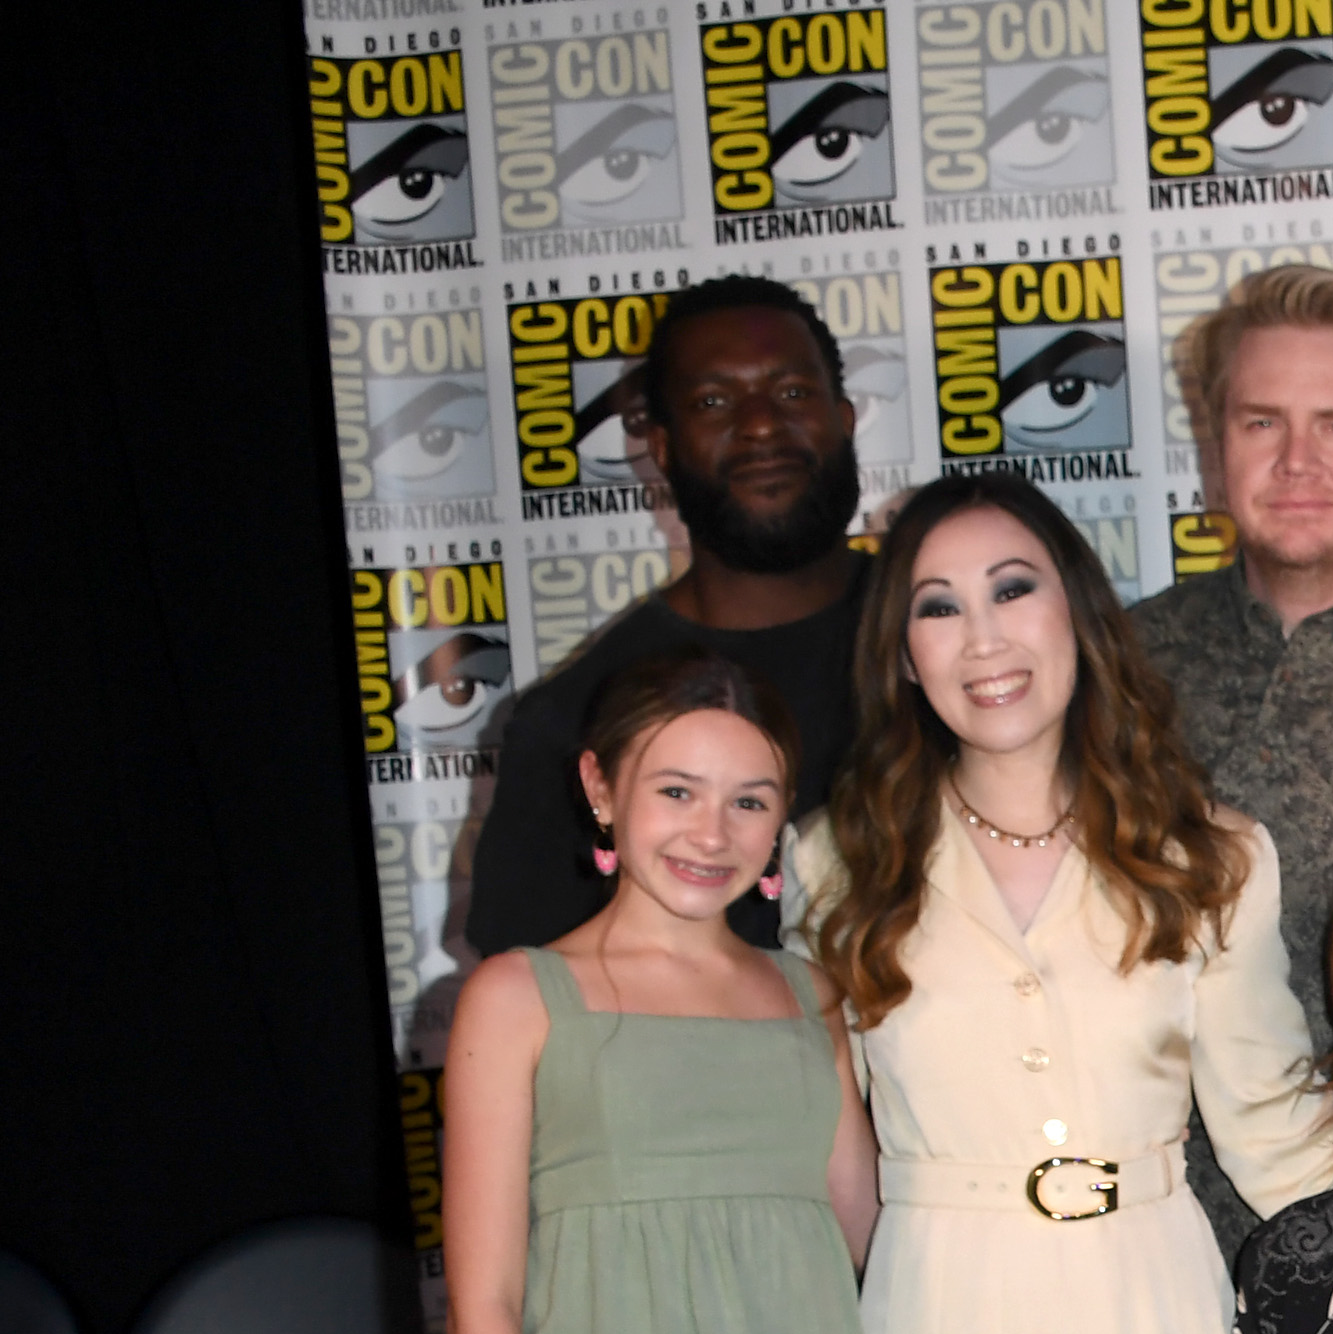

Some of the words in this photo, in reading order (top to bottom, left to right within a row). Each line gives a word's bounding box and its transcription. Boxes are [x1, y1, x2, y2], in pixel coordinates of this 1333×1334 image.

[365, 28, 461, 53] DIEGO
[485, 19, 542, 42] SAN
[571, 8, 669, 34] DIEGO
[766, 9, 887, 79] CON
[986, 0, 1108, 62] CON
[348, 52, 464, 119] CON
[555, 32, 673, 101] CON
[702, 23, 773, 211] COMIC
[918, 6, 988, 192] COMIC
[492, 44, 559, 229] COMIC
[801, 250, 900, 274] DIEGO
[926, 241, 986, 262] SAN
[1017, 235, 1121, 257] DIEGO
[384, 287, 481, 311] DIEGO
[504, 279, 560, 301] SAN
[589, 270, 689, 293] DIEGO
[999, 258, 1124, 324] CON
[367, 311, 483, 375] CON
[573, 295, 669, 358] CO
[931, 266, 1003, 455] COMIC
[510, 302, 578, 487] COMIC
[406, 540, 502, 563] DIEGO
[388, 562, 506, 627] CON
